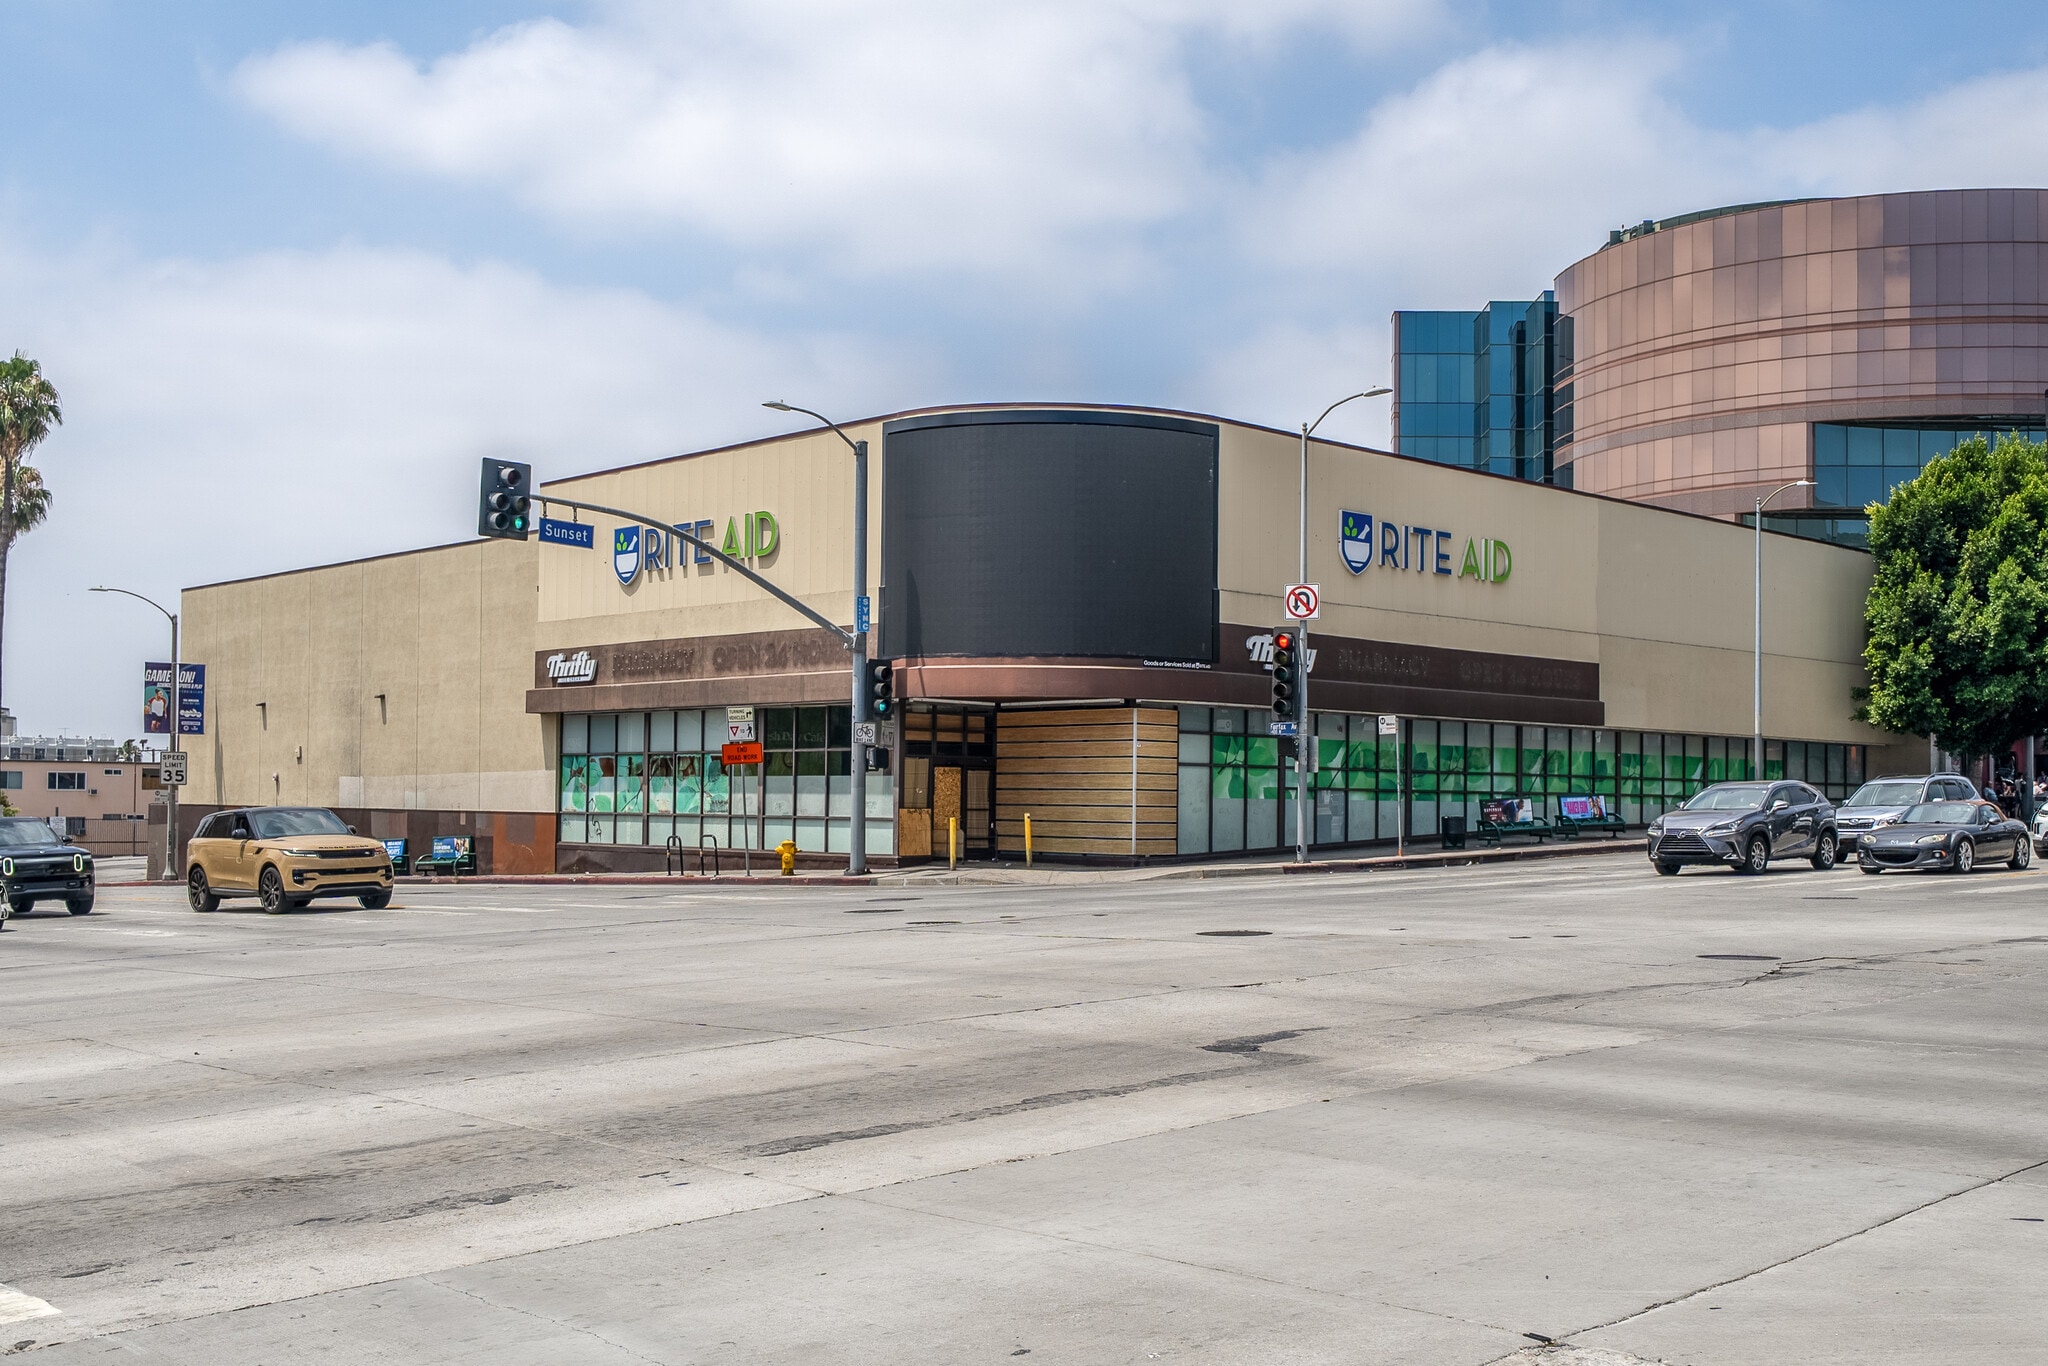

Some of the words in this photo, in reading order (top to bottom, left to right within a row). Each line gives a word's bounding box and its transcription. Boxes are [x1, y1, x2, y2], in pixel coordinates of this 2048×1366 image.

[545, 523, 588, 542] Sunset
[645, 519, 713, 571] RITE
[721, 510, 780, 559] AID
[1378, 520, 1452, 576] RITE
[1458, 535, 1513, 583] AID
[145, 669, 172, 682] GAME
[179, 671, 196, 683] ON!
[546, 650, 598, 682] Thrifty
[162, 769, 185, 782] 35
